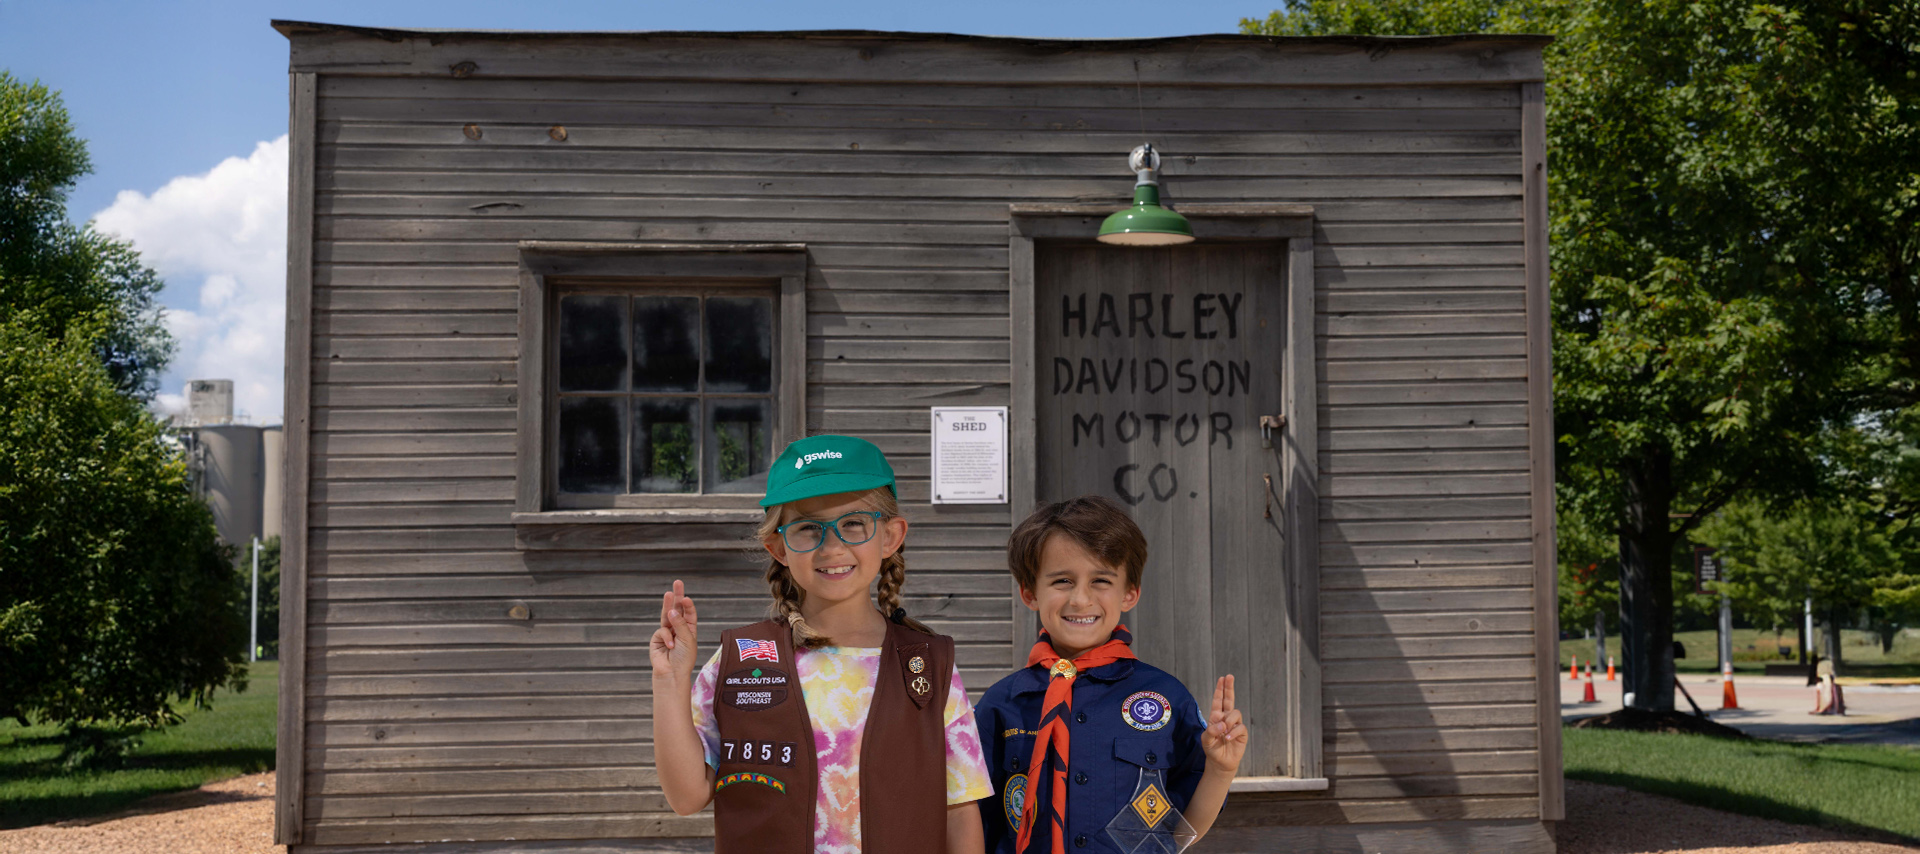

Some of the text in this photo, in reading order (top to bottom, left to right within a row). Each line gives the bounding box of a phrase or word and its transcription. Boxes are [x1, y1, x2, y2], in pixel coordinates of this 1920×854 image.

[1062, 293, 1242, 339] HARLEY
[1053, 357, 1250, 397] DAVIDSON
[952, 422, 987, 431] SHED
[1073, 410, 1233, 449] MOTOR
[804, 449, 843, 464] gswise
[1113, 463, 1198, 506] CO.
